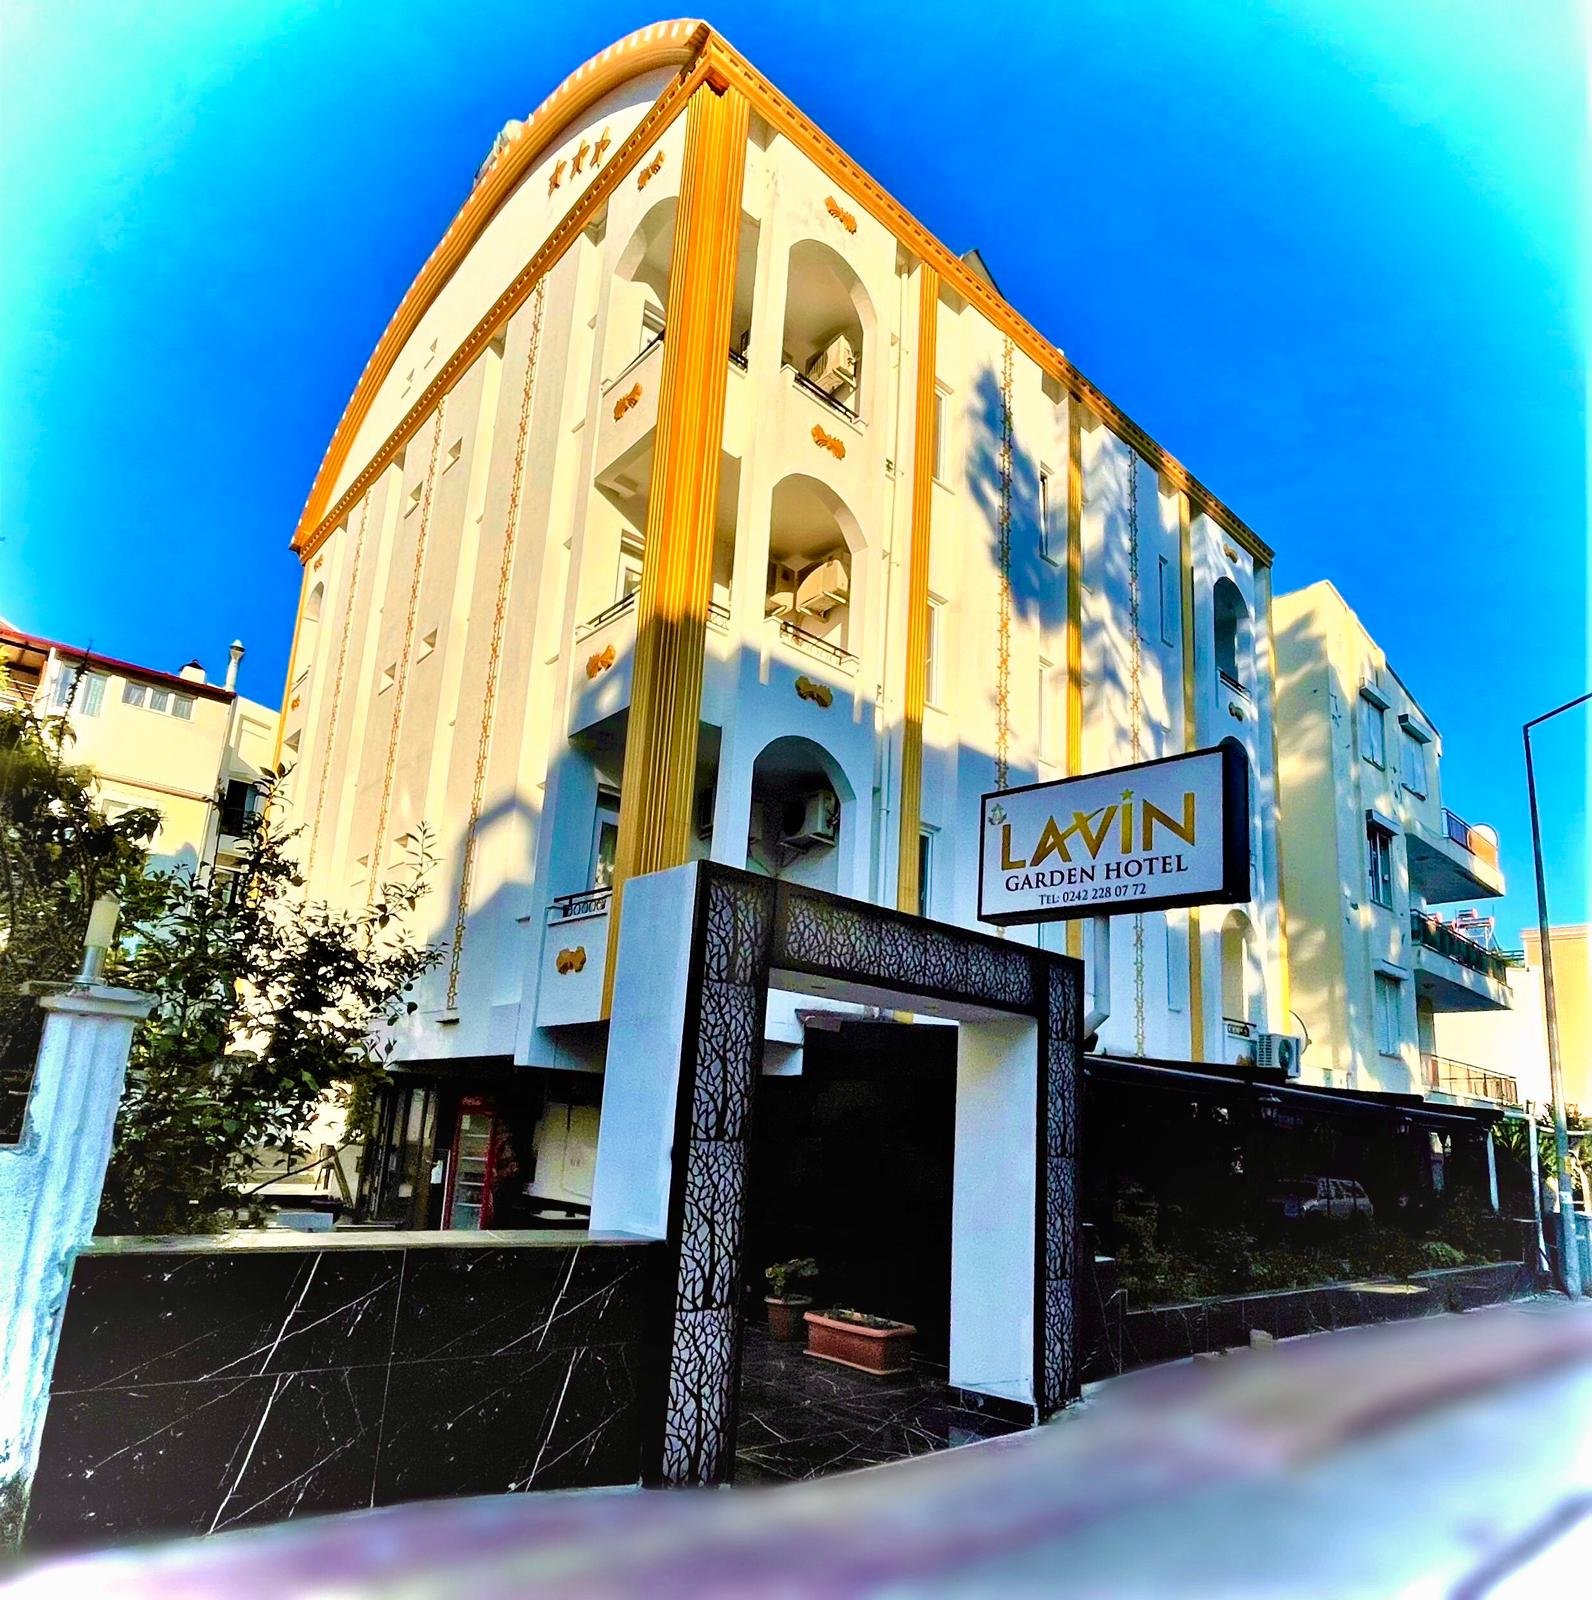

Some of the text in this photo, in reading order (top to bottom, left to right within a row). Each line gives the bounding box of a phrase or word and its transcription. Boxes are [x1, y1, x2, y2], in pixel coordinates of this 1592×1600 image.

[1005, 854, 1188, 892] GARDEN HOTEL
[1062, 890, 1088, 903] 0242
[1092, 887, 1111, 900] 228
[1114, 884, 1130, 897] 07
[1132, 883, 1147, 895] 72
